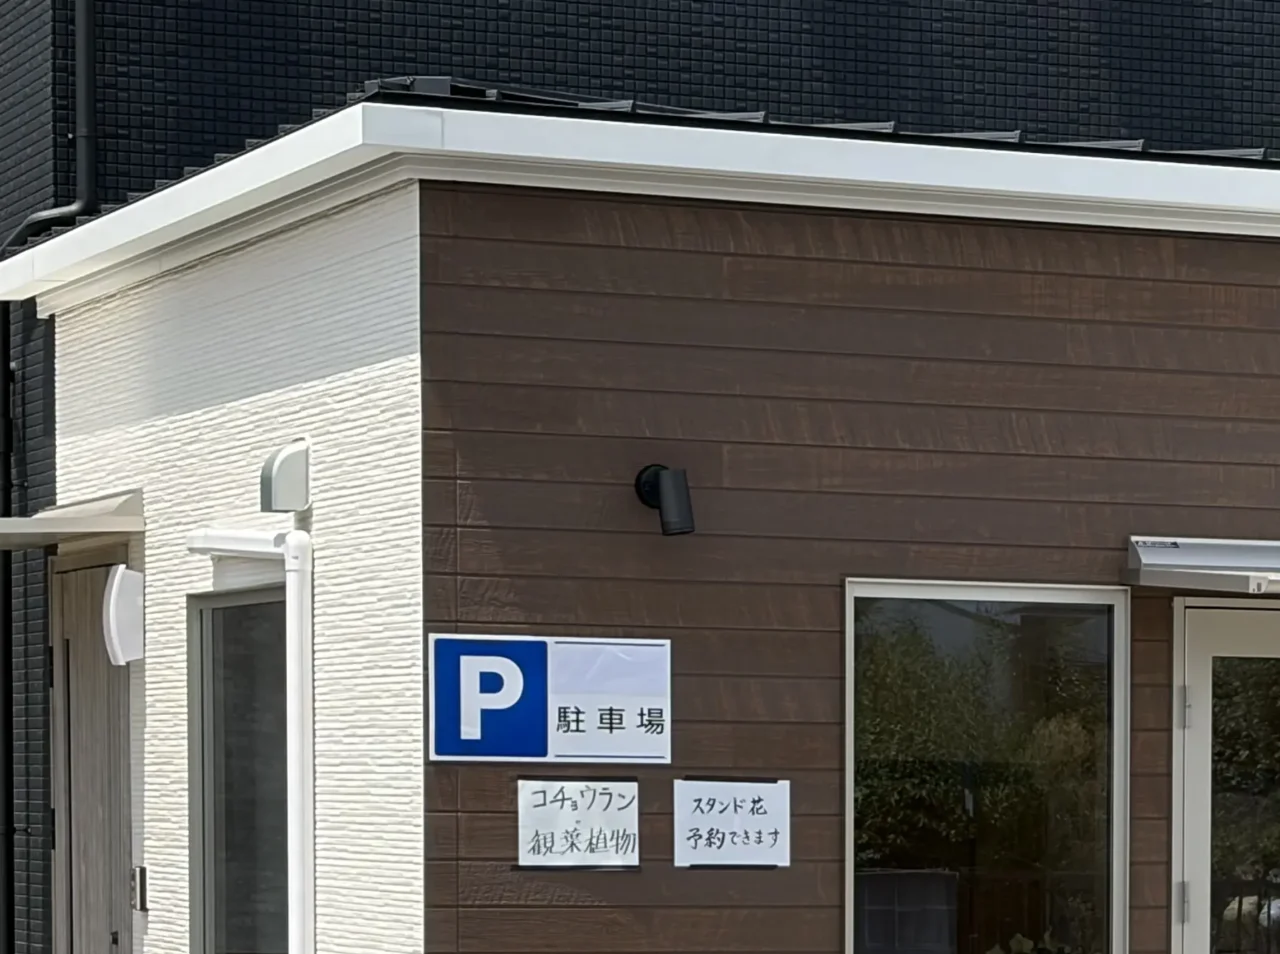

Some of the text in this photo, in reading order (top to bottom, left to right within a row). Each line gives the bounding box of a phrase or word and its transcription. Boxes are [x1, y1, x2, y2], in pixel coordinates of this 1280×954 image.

[460, 655, 524, 740] P
[556, 706, 666, 735] 駐車場
[532, 786, 636, 812] コチョウラン
[691, 796, 768, 816] スタンド花
[528, 828, 636, 856] 観葉植物
[686, 827, 781, 850] 予約できます
